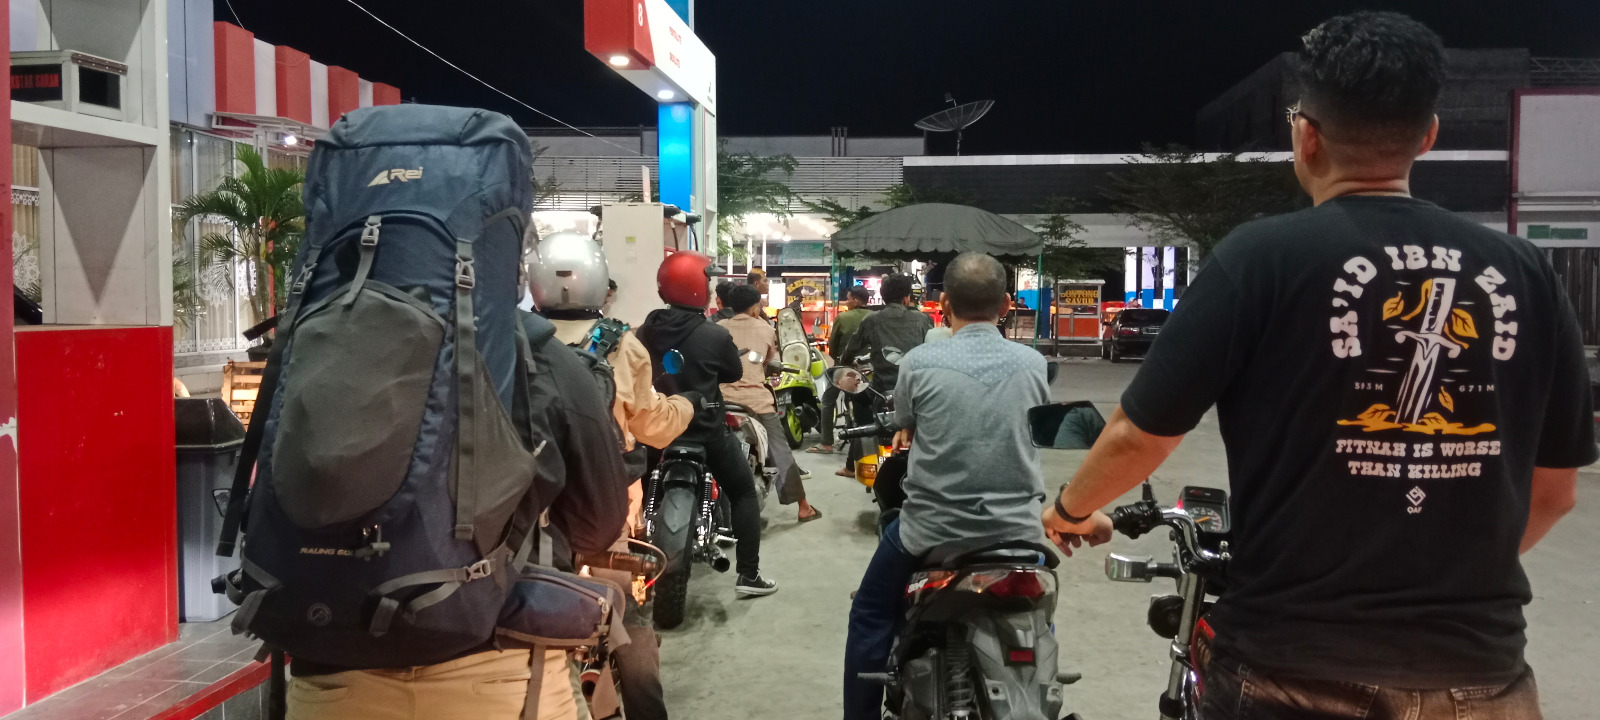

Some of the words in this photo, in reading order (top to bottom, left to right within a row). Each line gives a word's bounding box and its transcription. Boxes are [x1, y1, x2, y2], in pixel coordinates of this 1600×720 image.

[638, 3, 643, 27] 8
[1384, 245, 1461, 271] IBN
[1474, 266, 1518, 361] ZAID
[1336, 440, 1406, 457] FITNAH
[1413, 443, 1433, 458] IS
[1440, 441, 1501, 457] WORSE
[1348, 461, 1401, 477] THAN
[1408, 462, 1481, 479] KILLING
